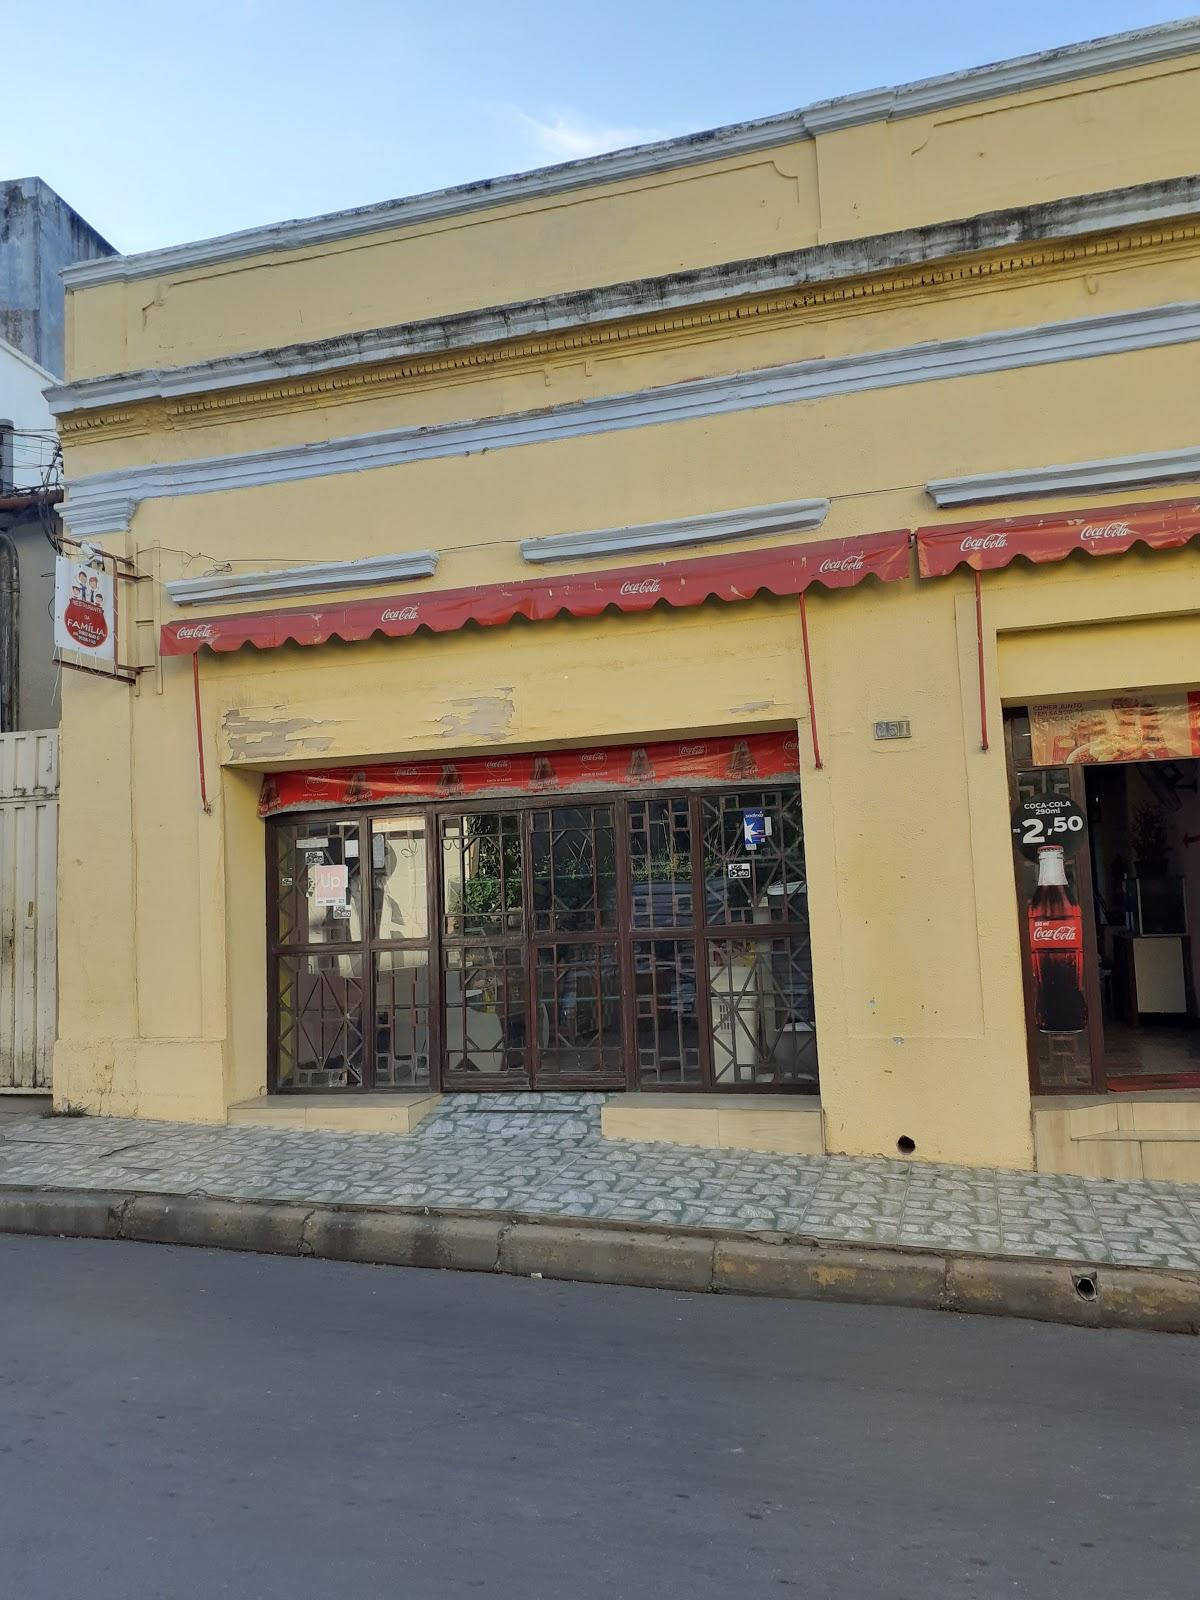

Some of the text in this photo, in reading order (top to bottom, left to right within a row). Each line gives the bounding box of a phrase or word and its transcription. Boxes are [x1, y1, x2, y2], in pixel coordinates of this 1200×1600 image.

[1024, 800, 1071, 809] COCA-COLA
[1022, 815, 1083, 843] 2,50
[1033, 926, 1076, 941] Coca-Cola
